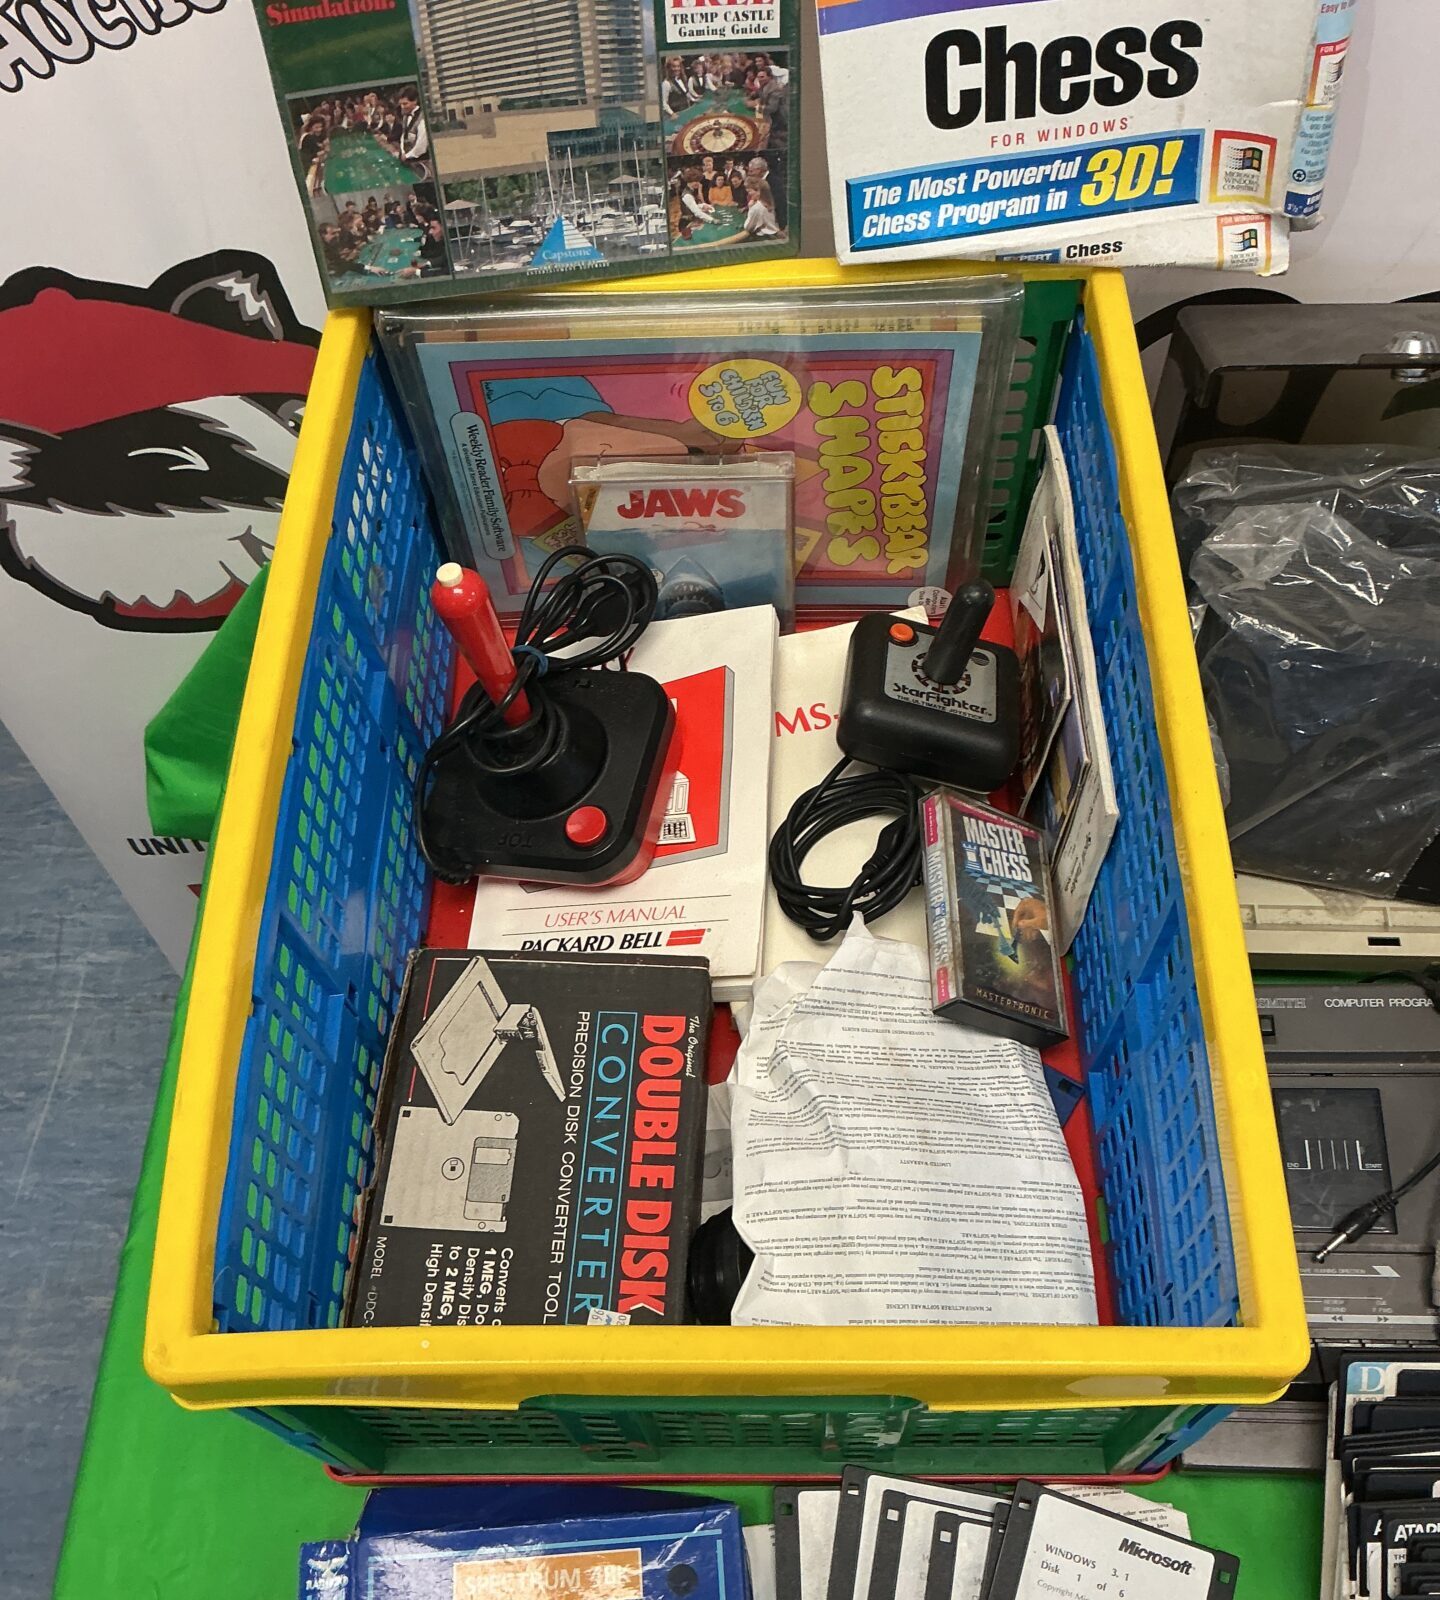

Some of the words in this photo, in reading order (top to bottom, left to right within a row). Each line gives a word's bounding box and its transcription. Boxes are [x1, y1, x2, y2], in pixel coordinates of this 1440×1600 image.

[671, 12, 718, 24] TRUMP
[724, 10, 774, 22] CASTLE
[1320, 2, 1338, 14] Easy
[678, 26, 726, 37] Gaming
[731, 24, 768, 36] Guide
[924, 20, 1203, 130] Chess
[990, 132, 1027, 149] FOR
[1037, 117, 1130, 143] WINDOWS
[862, 186, 902, 210] The
[906, 172, 969, 203] Most
[971, 156, 1082, 193] Powerful
[1080, 140, 1184, 208] 3D!
[862, 208, 931, 238] Chess
[937, 195, 1041, 229] Program
[1046, 188, 1069, 212] in
[542, 249, 592, 261] Capstone
[1066, 240, 1124, 259] Chess
[699, 382, 723, 398] 3
[707, 396, 724, 412] TO
[720, 369, 767, 431] CHILDREN
[746, 378, 774, 408] FOR
[760, 371, 791, 406] FUN
[716, 411, 739, 426] 6
[466, 424, 484, 460] Weekly
[475, 459, 490, 490] Reader
[808, 380, 880, 566] SHAPES
[871, 365, 928, 574] STICKYBEAR
[483, 488, 500, 516] Family
[617, 488, 746, 519] JAWS
[490, 516, 506, 552] Software
[893, 683, 987, 714] StarFighter
[912, 698, 946, 711] ULTIMATE
[775, 702, 839, 737] MS-
[498, 830, 534, 848] TOP
[962, 816, 1028, 856] MASTER
[927, 850, 946, 911] MASTER
[979, 846, 1033, 883] CHESS
[544, 909, 603, 928] USER'S
[606, 905, 688, 924] MANUAL
[520, 934, 614, 952] PACKARD
[619, 931, 663, 950] BELL
[932, 918, 950, 966] CHESS
[975, 988, 1051, 1020] MASTERTRONIC
[1324, 998, 1384, 1008] COMPUTER
[690, 1016, 700, 1033] The
[566, 1011, 590, 1098] PRECISION
[685, 1035, 700, 1078] Original
[630, 1015, 686, 1188] DOUBLE
[564, 1106, 580, 1144] DISK
[573, 1023, 629, 1314] CONVERTER
[550, 1151, 575, 1264] CONVERTER
[370, 1236, 388, 1278] MODEL
[426, 1244, 444, 1278] High
[448, 1246, 462, 1260] to
[617, 1200, 672, 1316] DISK
[446, 1268, 458, 1277] 2
[459, 1248, 480, 1300] Density
[476, 1260, 495, 1298] MEG,
[494, 1248, 513, 1312] Converts
[437, 1282, 456, 1320] MEG,
[542, 1272, 562, 1325] TOOL
[1360, 1366, 1384, 1392] D
[1044, 1543, 1098, 1569] WINDOWS
[1118, 1538, 1193, 1576] Microsoft
[464, 1567, 582, 1592] SPECTRUM
[1036, 1578, 1074, 1599] Copyright
[1040, 1560, 1060, 1576] Disk
[1076, 1572, 1082, 1582] 1
[1096, 1582, 1107, 1592] of
[1118, 1589, 1126, 1598] 6
